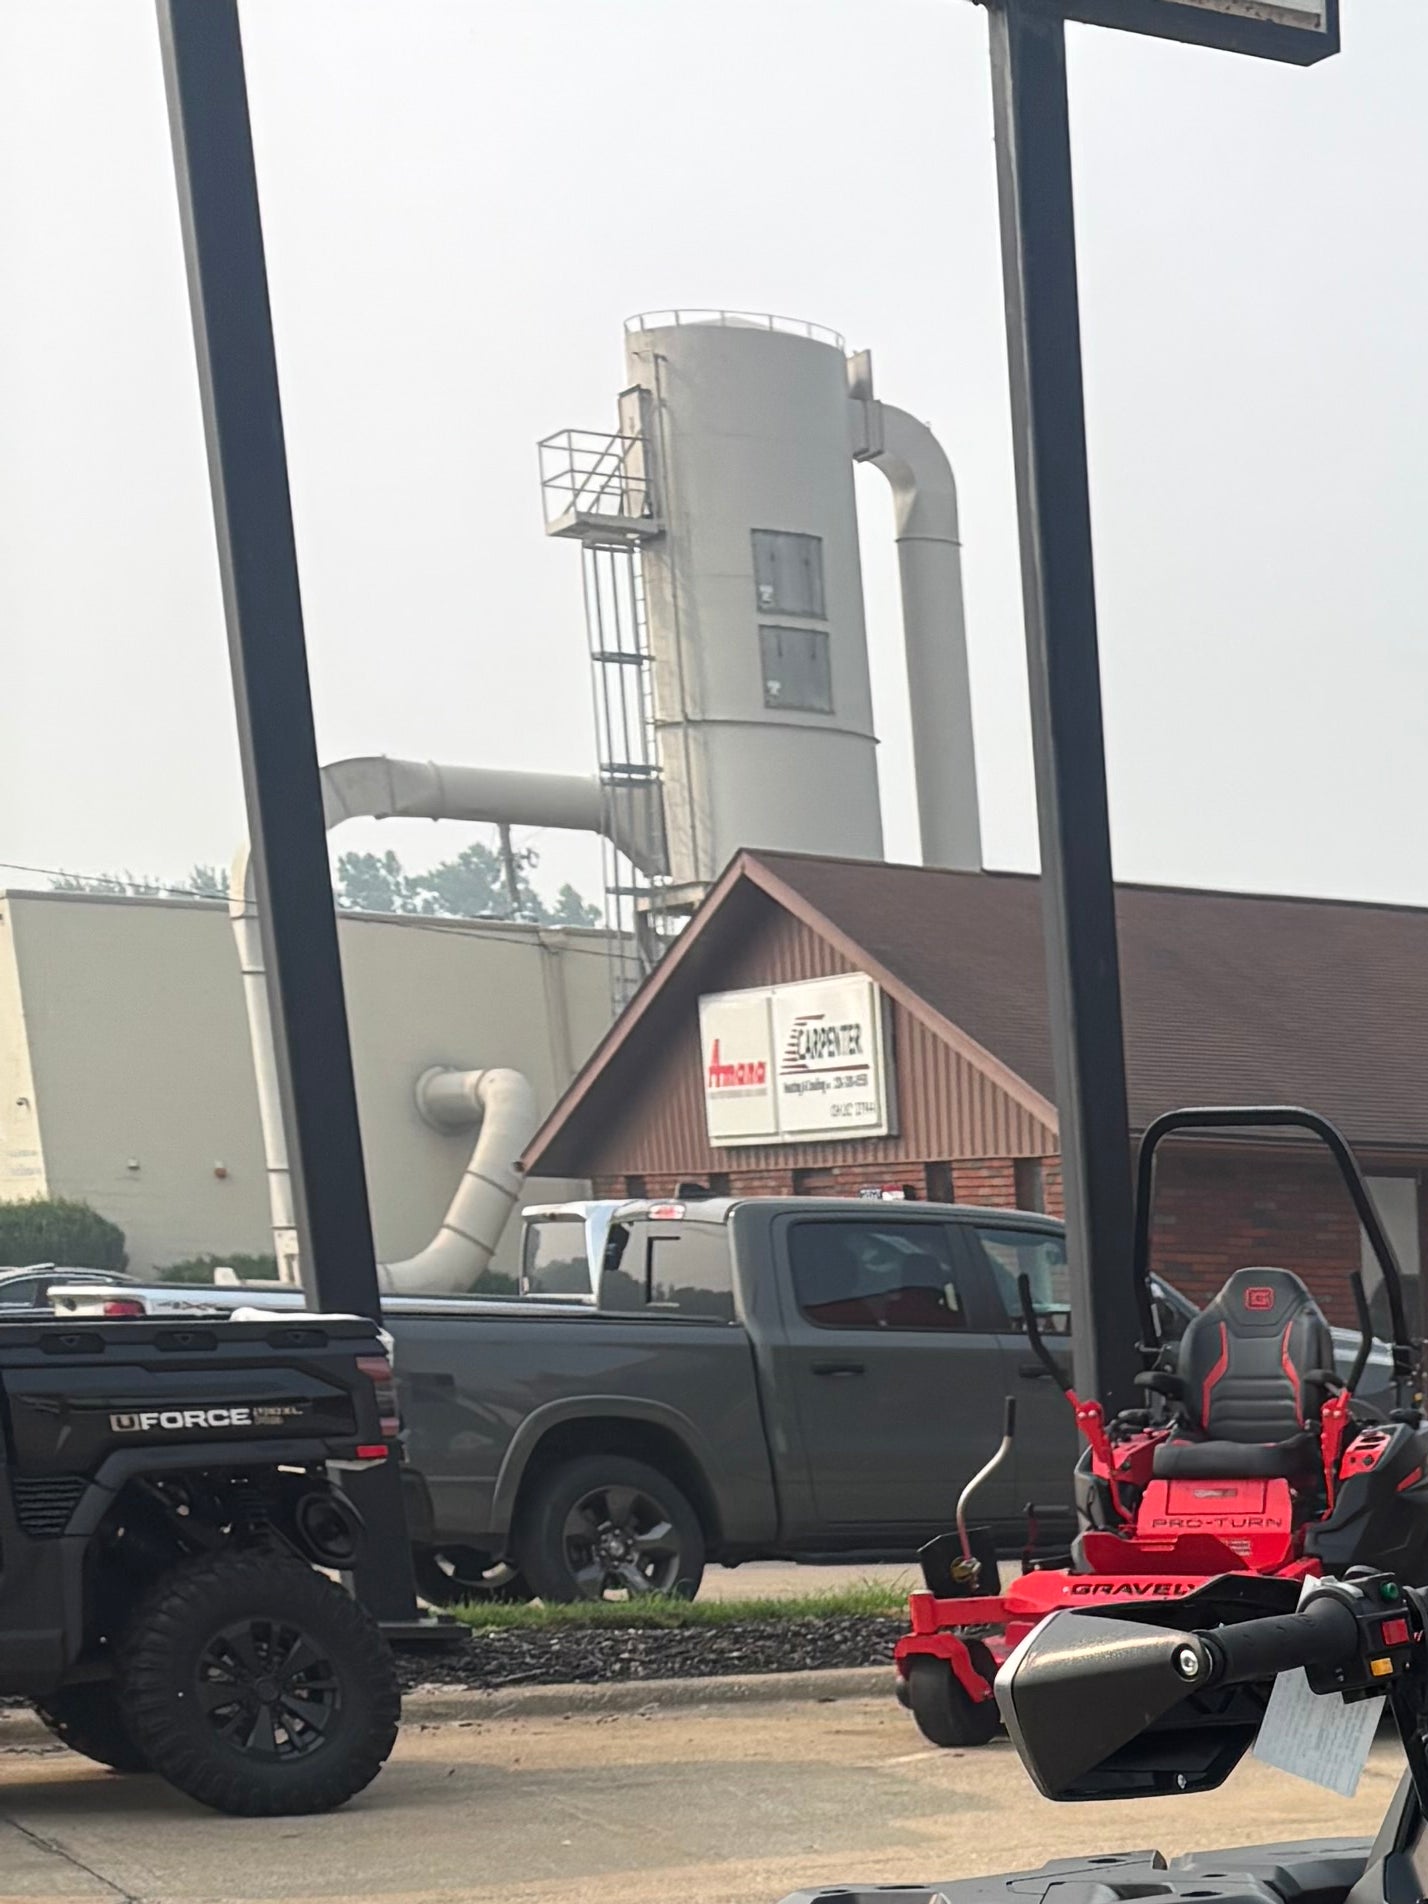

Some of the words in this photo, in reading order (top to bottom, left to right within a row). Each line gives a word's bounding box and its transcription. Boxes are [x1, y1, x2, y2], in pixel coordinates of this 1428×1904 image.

[797, 1023, 863, 1061] CARPENTER
[709, 1039, 767, 1088] Amana
[109, 1407, 252, 1432] UFORCE
[1152, 1517, 1282, 1529] PRO-TURN
